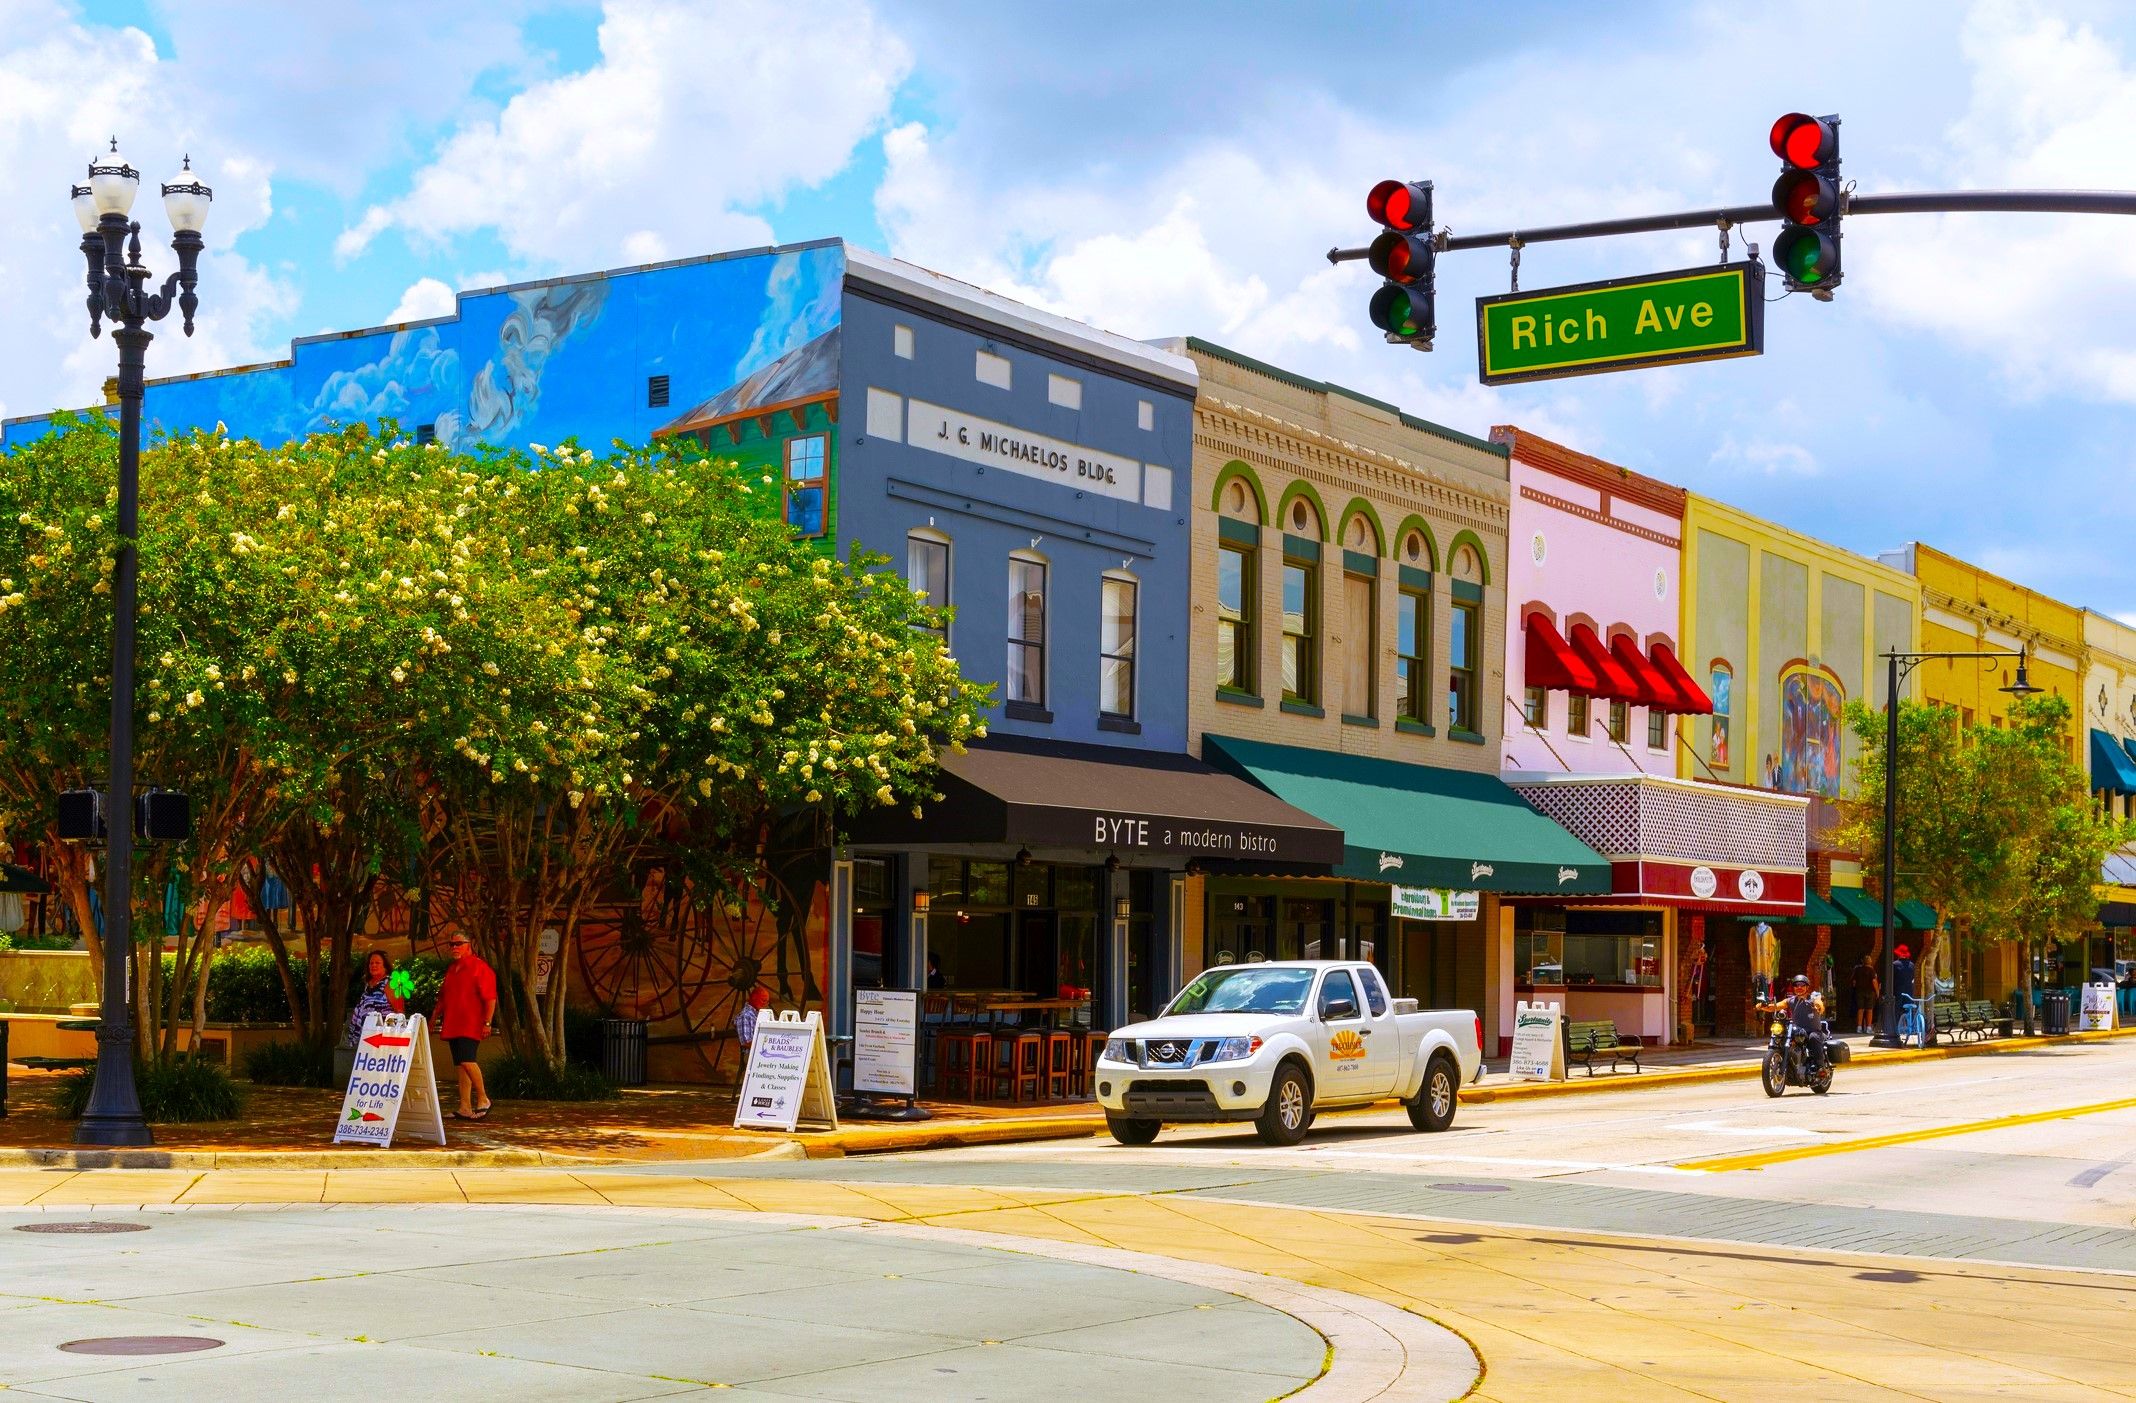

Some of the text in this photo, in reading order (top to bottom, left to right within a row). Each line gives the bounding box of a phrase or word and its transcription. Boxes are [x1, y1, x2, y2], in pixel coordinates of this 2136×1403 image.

[1511, 299, 1713, 350] Rich Ave
[937, 421, 1117, 485] J. G. MICHAELOS BLDG.
[1095, 816, 1277, 853] BYTE a modern bistro
[768, 1037, 790, 1046] BEADS
[776, 1045, 803, 1053] BAUBLES
[354, 1052, 407, 1074] Health
[757, 1061, 799, 1071] Jewelry Making
[752, 1073, 800, 1082] Findings, Supplies
[348, 1077, 400, 1098] Foods
[356, 1099, 384, 1109] for Life
[338, 1124, 389, 1137] 386-734-2343
